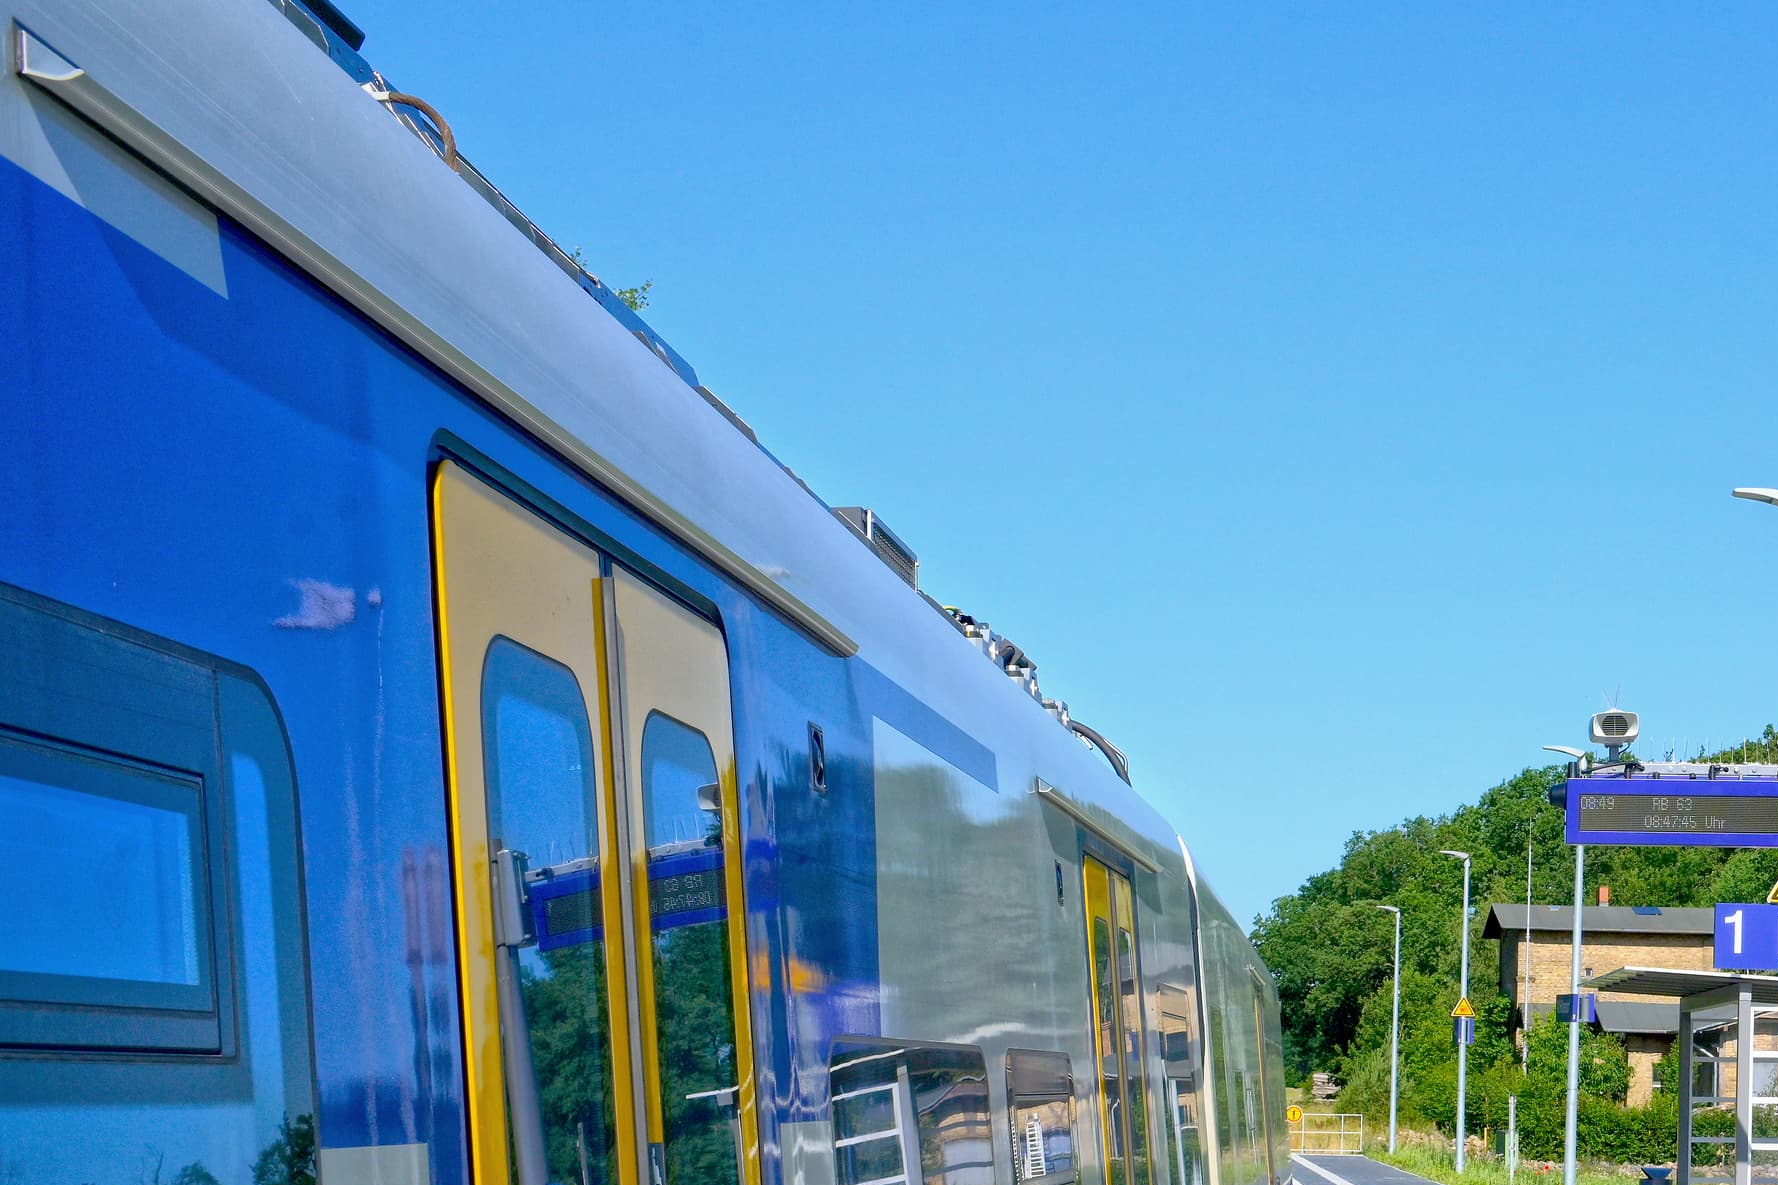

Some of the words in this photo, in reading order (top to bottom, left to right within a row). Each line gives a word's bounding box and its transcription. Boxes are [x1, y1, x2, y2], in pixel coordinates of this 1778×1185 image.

[1580, 796, 1615, 811] 08:49
[1652, 797, 1669, 811] RB
[1676, 798, 1693, 811] 63
[1643, 815, 1697, 829] 08:47:45
[1705, 815, 1727, 829] Uhr
[1724, 909, 1744, 954] 1
